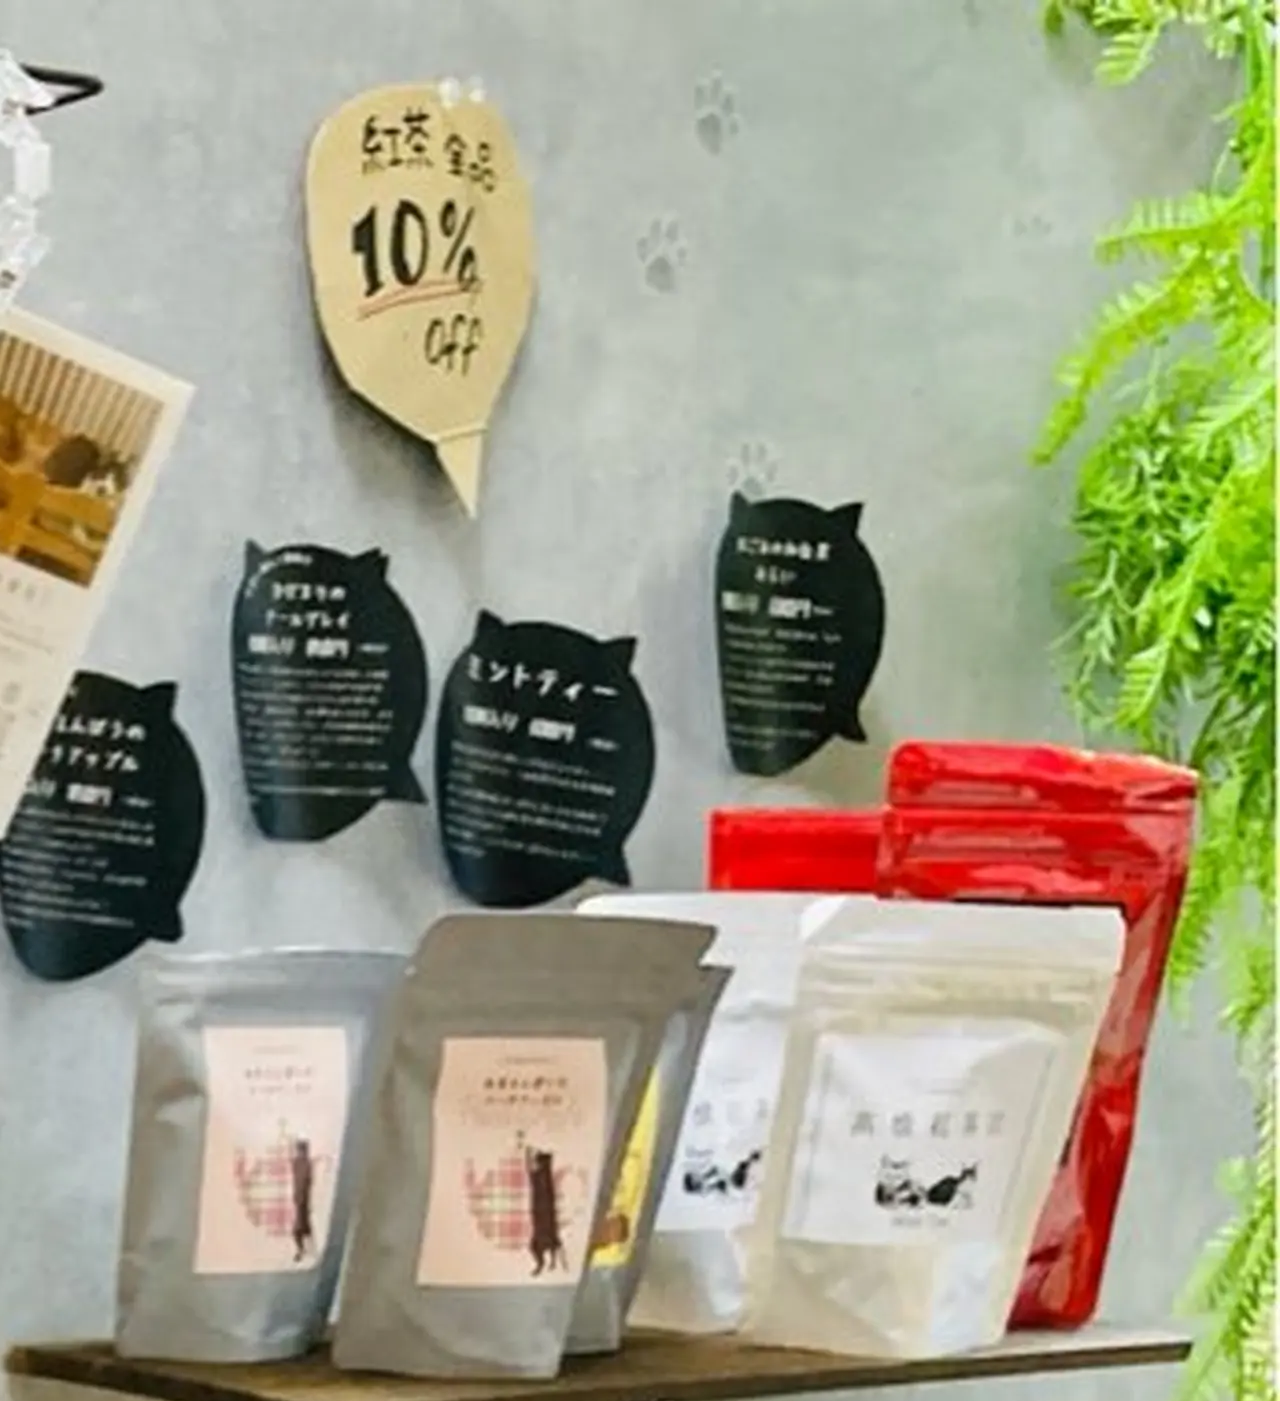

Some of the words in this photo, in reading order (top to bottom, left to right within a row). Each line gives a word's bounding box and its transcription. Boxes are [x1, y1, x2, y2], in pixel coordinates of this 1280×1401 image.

[351, 199, 484, 298] 10%
[467, 653, 620, 701] ミントティー
